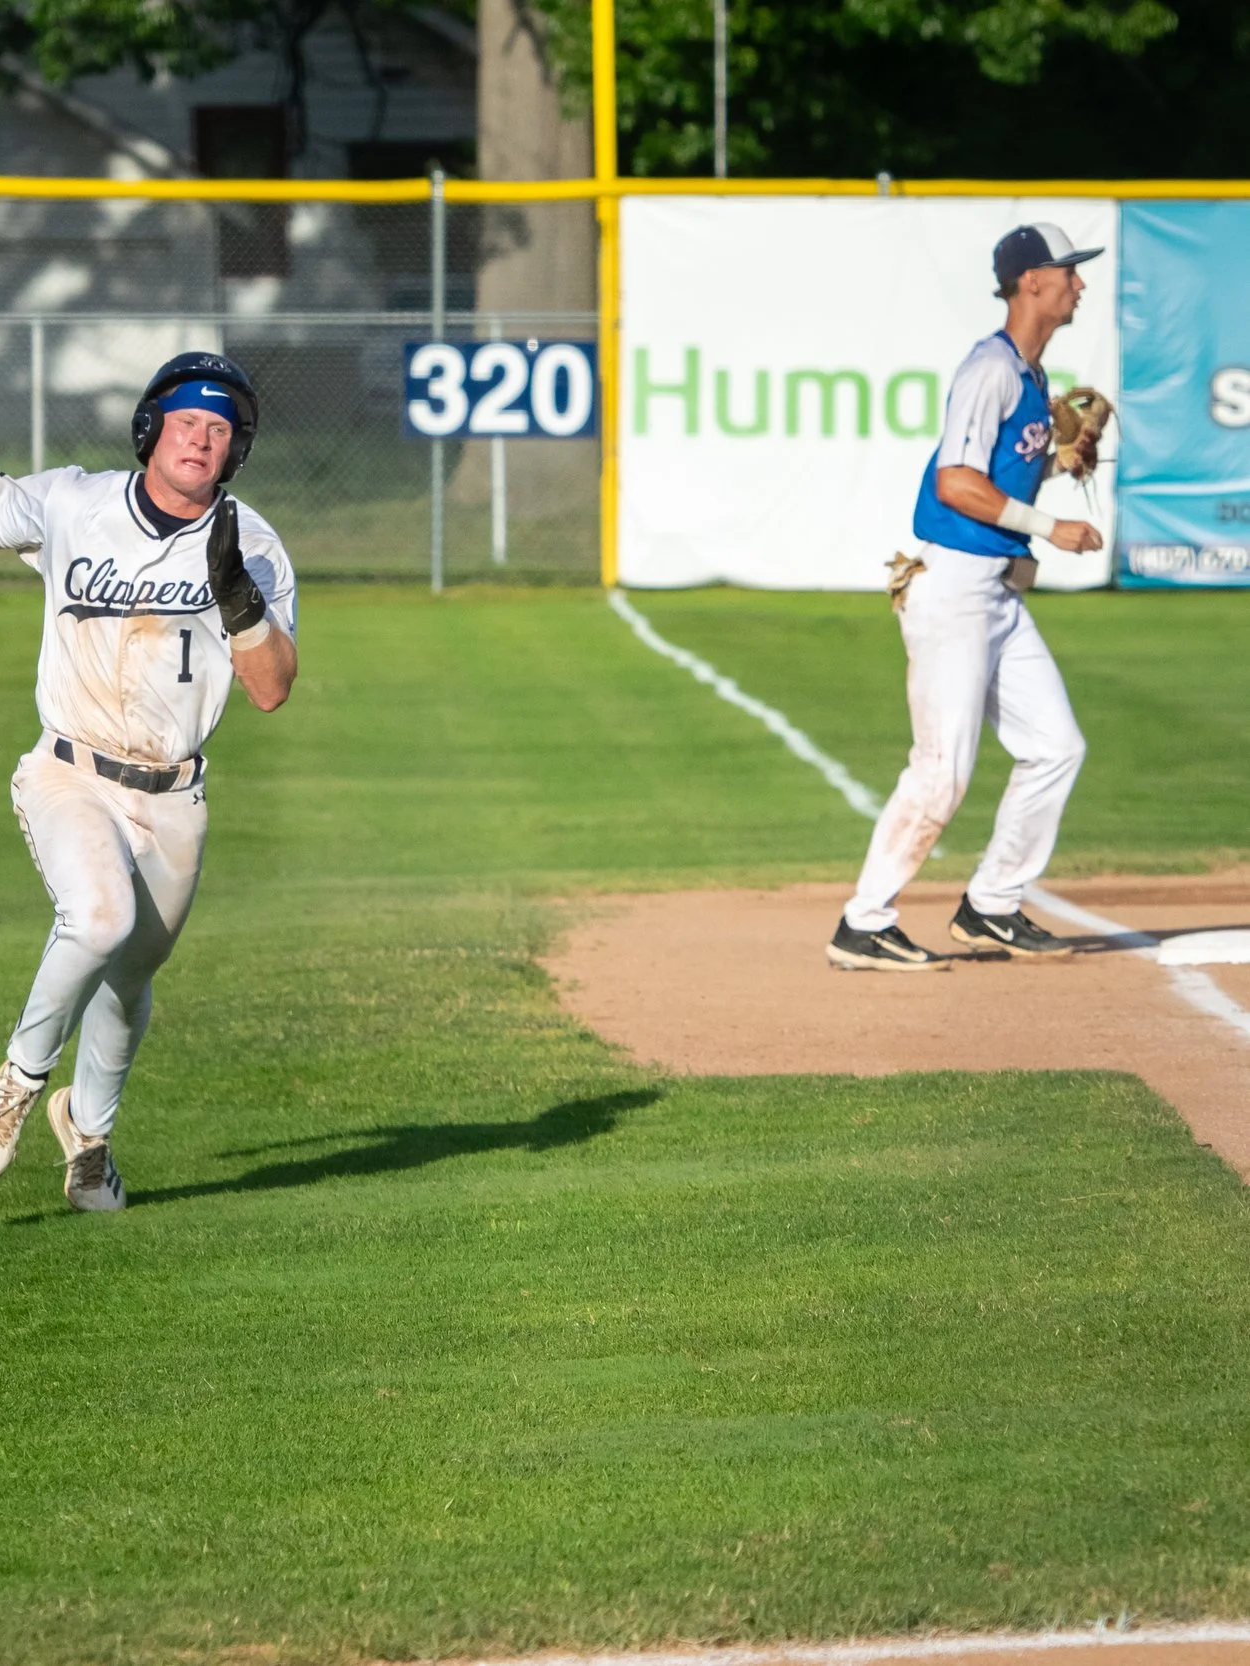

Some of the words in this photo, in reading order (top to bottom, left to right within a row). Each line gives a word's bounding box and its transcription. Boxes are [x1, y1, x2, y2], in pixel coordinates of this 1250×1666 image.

[408, 343, 593, 436] 320
[632, 346, 1077, 438] Huma
[64, 556, 220, 609] Clippers
[178, 629, 193, 683] 1
